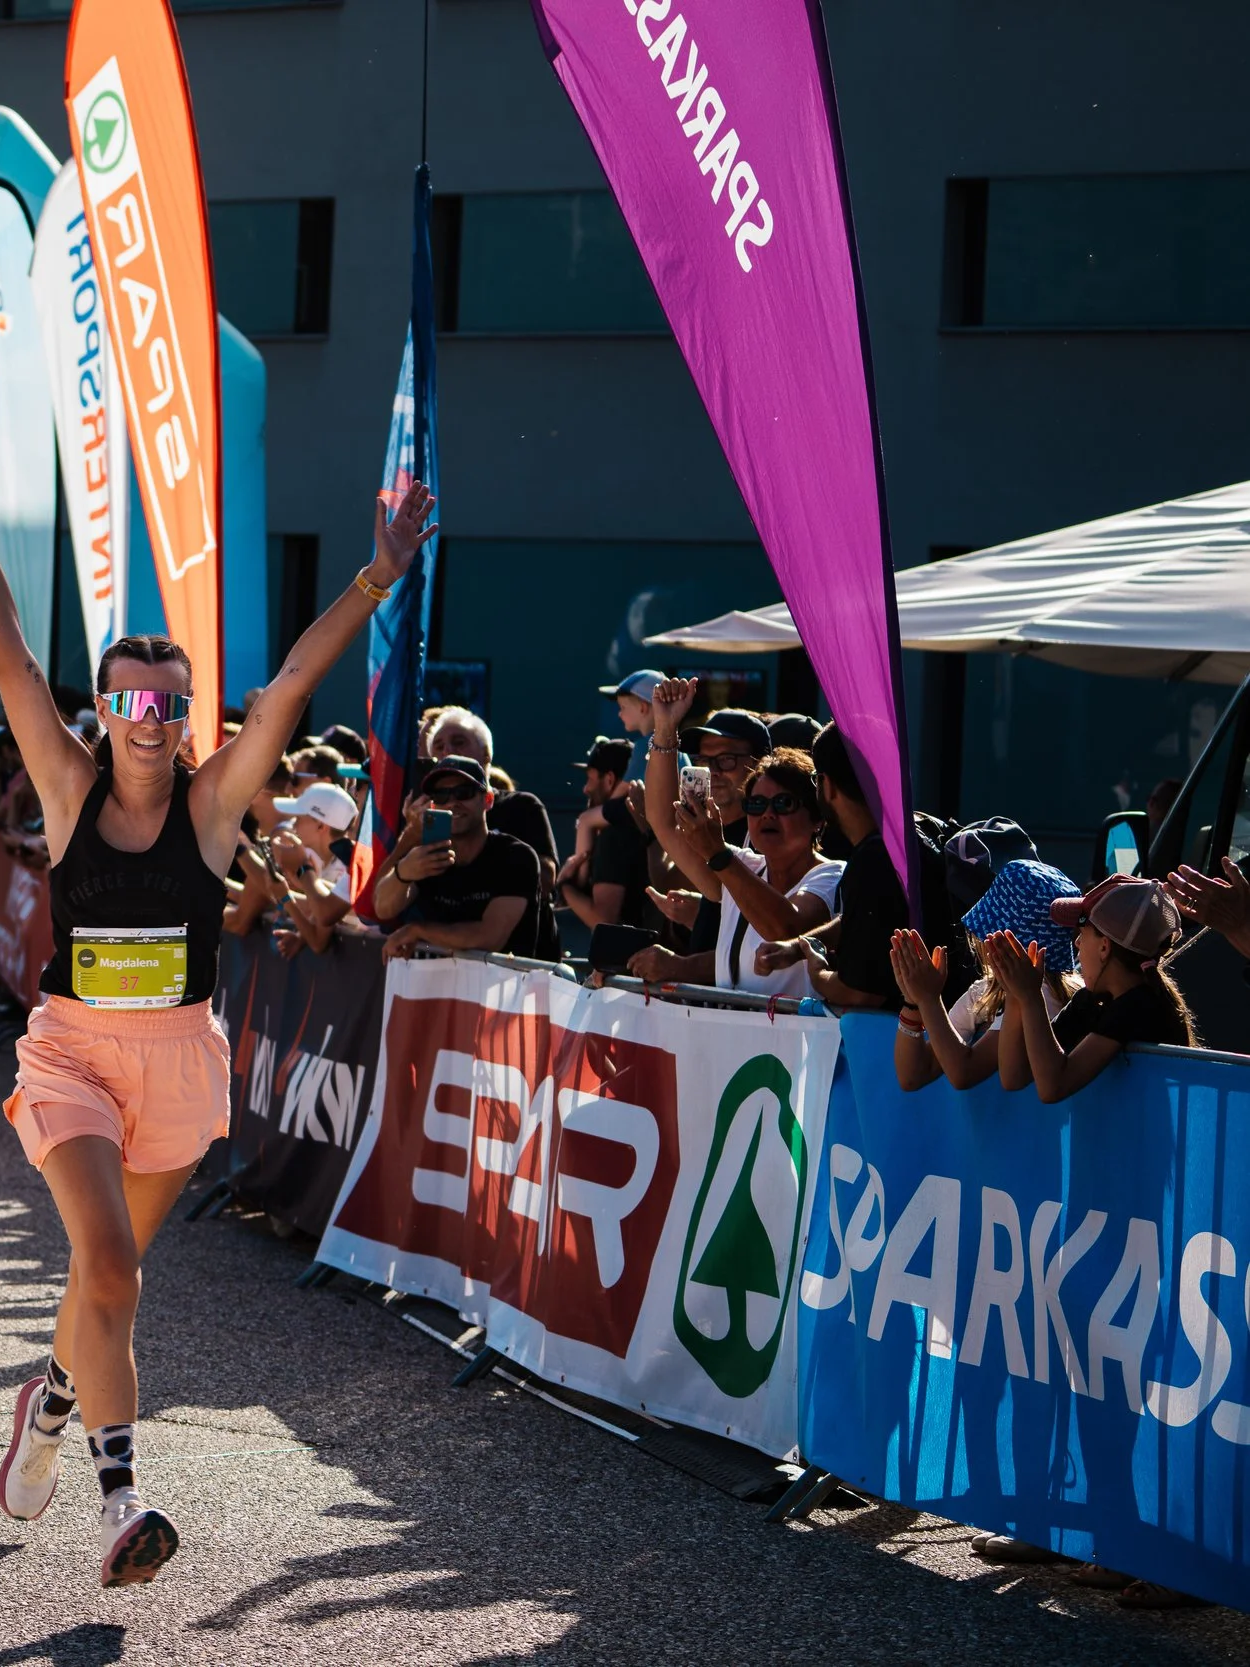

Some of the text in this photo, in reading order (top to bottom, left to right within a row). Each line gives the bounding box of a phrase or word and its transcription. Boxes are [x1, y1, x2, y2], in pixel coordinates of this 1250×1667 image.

[99, 957, 160, 970] Magdalena
[119, 976, 139, 990] 37
[800, 1143, 1250, 1446] SPARKAS
